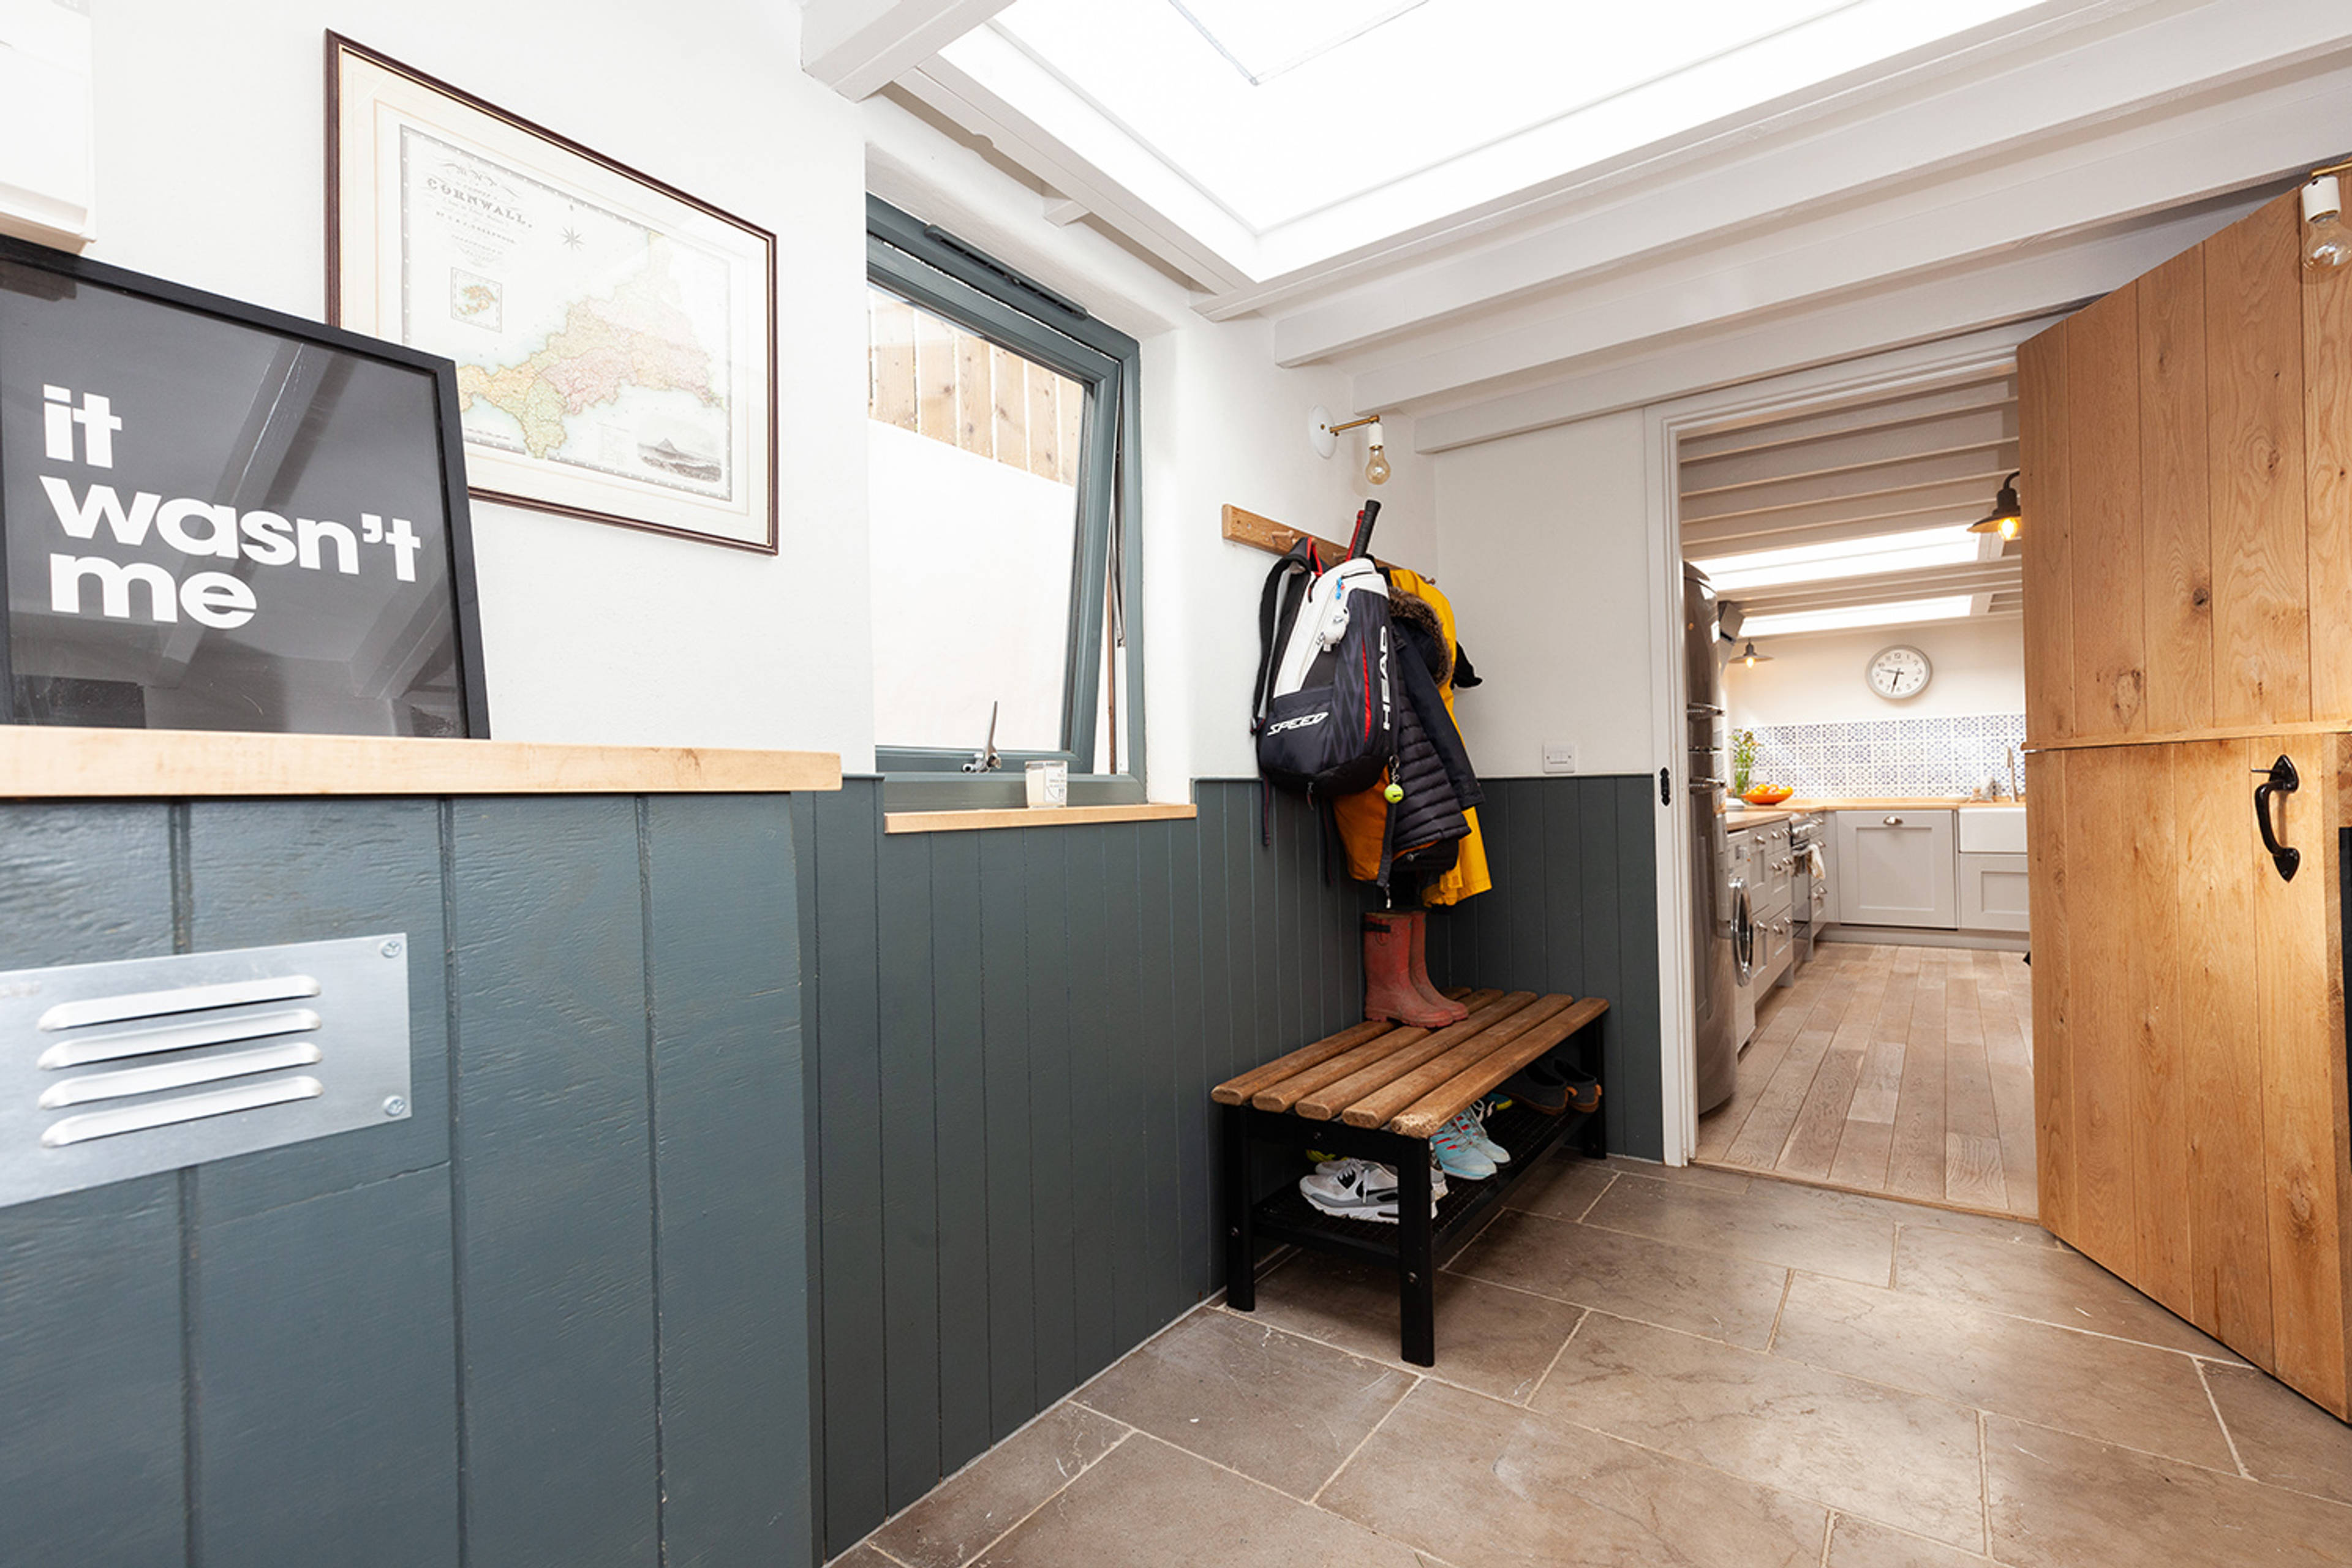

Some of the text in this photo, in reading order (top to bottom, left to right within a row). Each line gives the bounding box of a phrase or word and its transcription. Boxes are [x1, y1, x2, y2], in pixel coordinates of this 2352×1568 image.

[43, 383, 122, 468] it
[39, 475, 421, 582] wasn't
[50, 553, 257, 629] me
[1379, 625, 1390, 731] HEAD
[1267, 712, 1329, 736] SPEED
